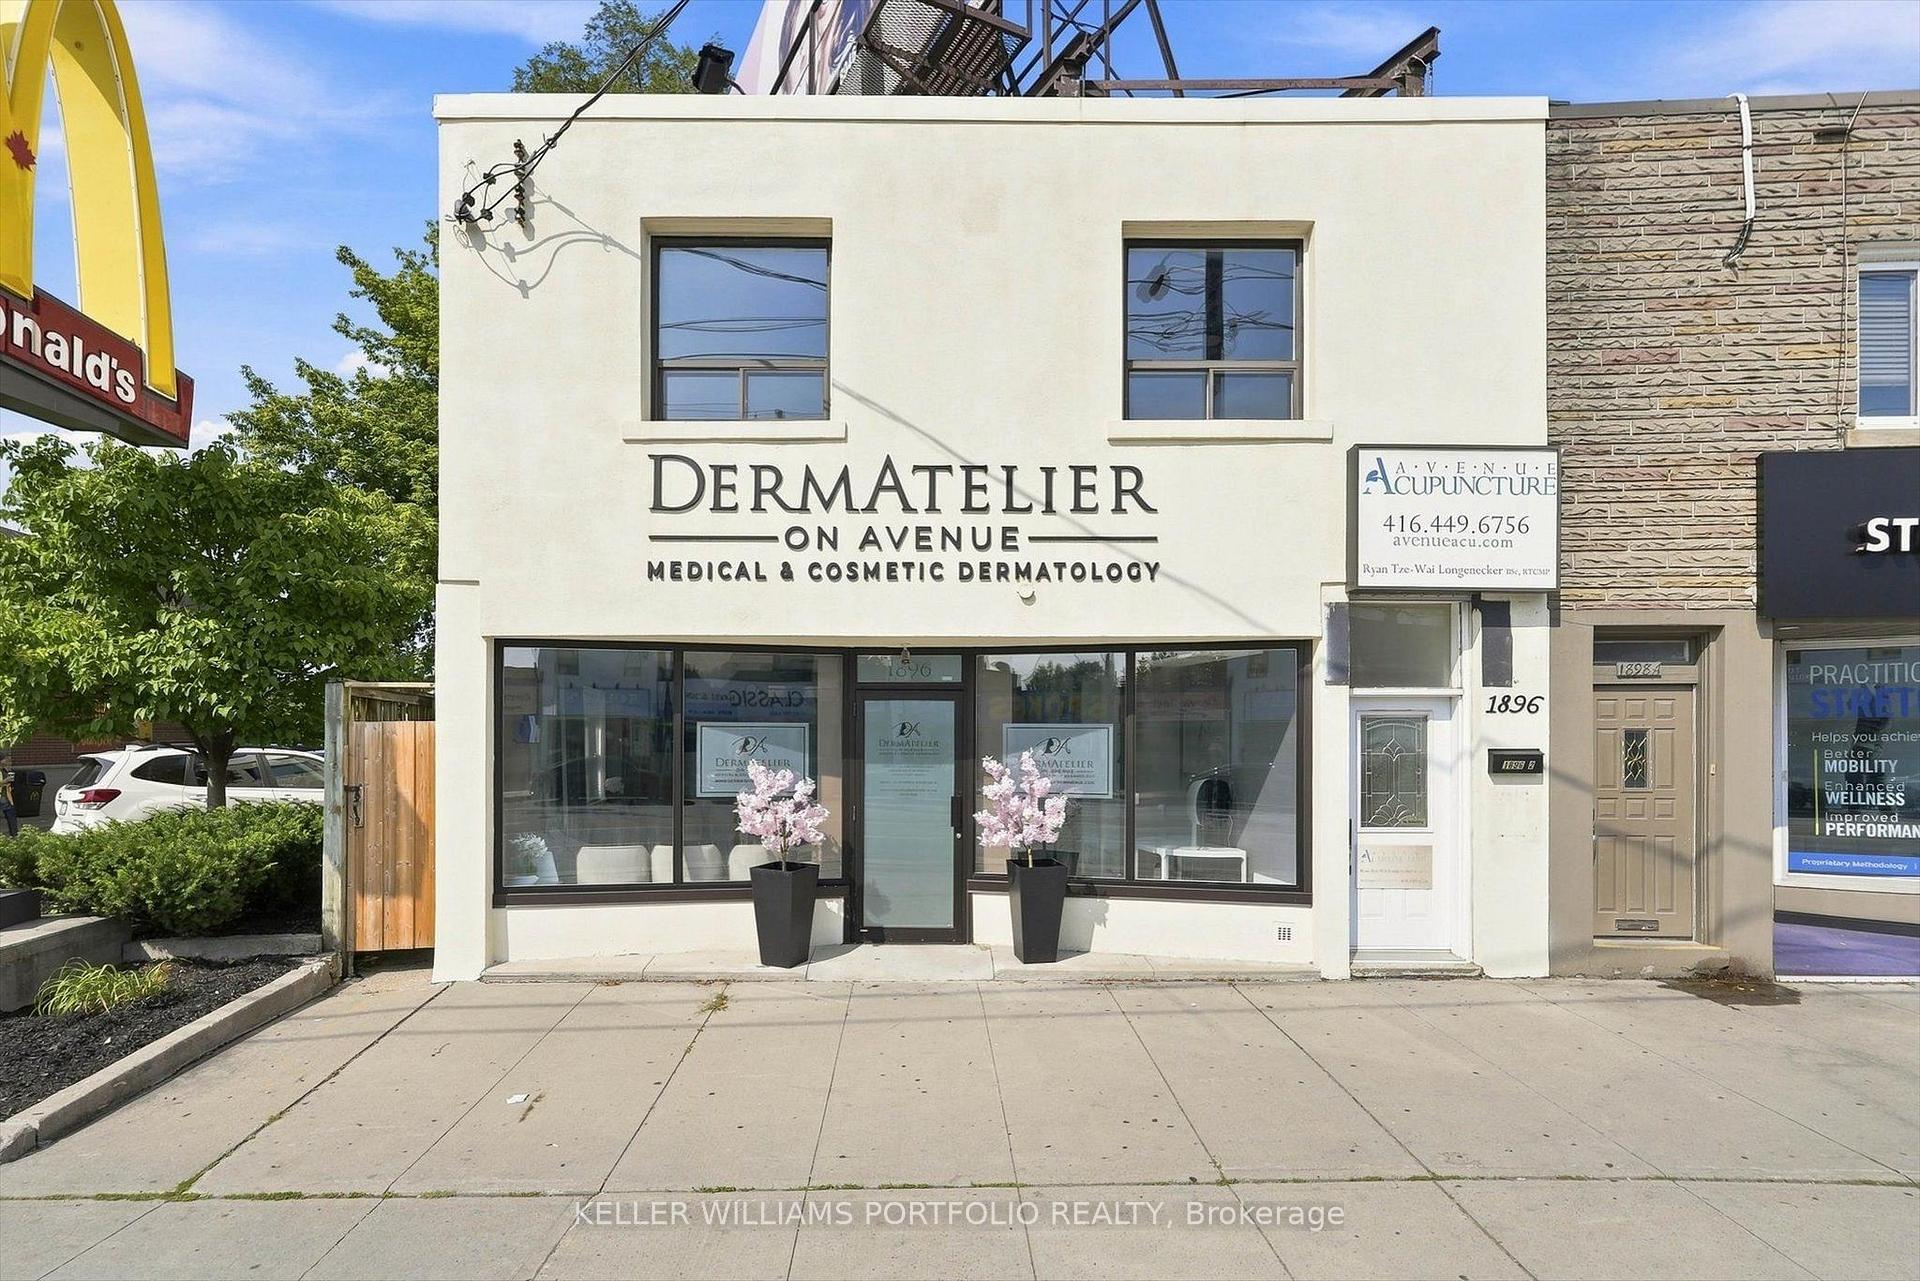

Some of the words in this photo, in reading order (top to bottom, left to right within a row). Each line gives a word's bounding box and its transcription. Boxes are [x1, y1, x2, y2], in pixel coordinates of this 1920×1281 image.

[1362, 457, 1556, 496] ACUPUNCTURE
[1383, 514, 1530, 534] 416.449.6756
[785, 526, 838, 551] ON
[858, 526, 1019, 551] AVENUE
[1393, 535, 1513, 548] avenueacu.com
[647, 561, 767, 582] MEDICAL
[780, 561, 794, 581] &
[808, 561, 944, 582] COSMETIC
[958, 562, 1160, 582] DERMATOLOGY
[1363, 564, 1388, 577] Ryan
[1391, 564, 1435, 575] Tze-Wai
[1438, 564, 1503, 578] Longenecker
[1618, 662, 1662, 676] 1898A
[1485, 695, 1544, 714] 1896
[1812, 732, 1849, 744] Helps
[1852, 733, 1877, 744] you
[1824, 749, 1873, 759] Better
[1824, 759, 1898, 773] MOBILITY
[1824, 780, 1905, 792] Enhanced
[1825, 791, 1905, 806] WELLNESS
[1825, 812, 1899, 823] Improved
[1801, 858, 1851, 868] Proprietary
[1852, 861, 1908, 870] Methodology
